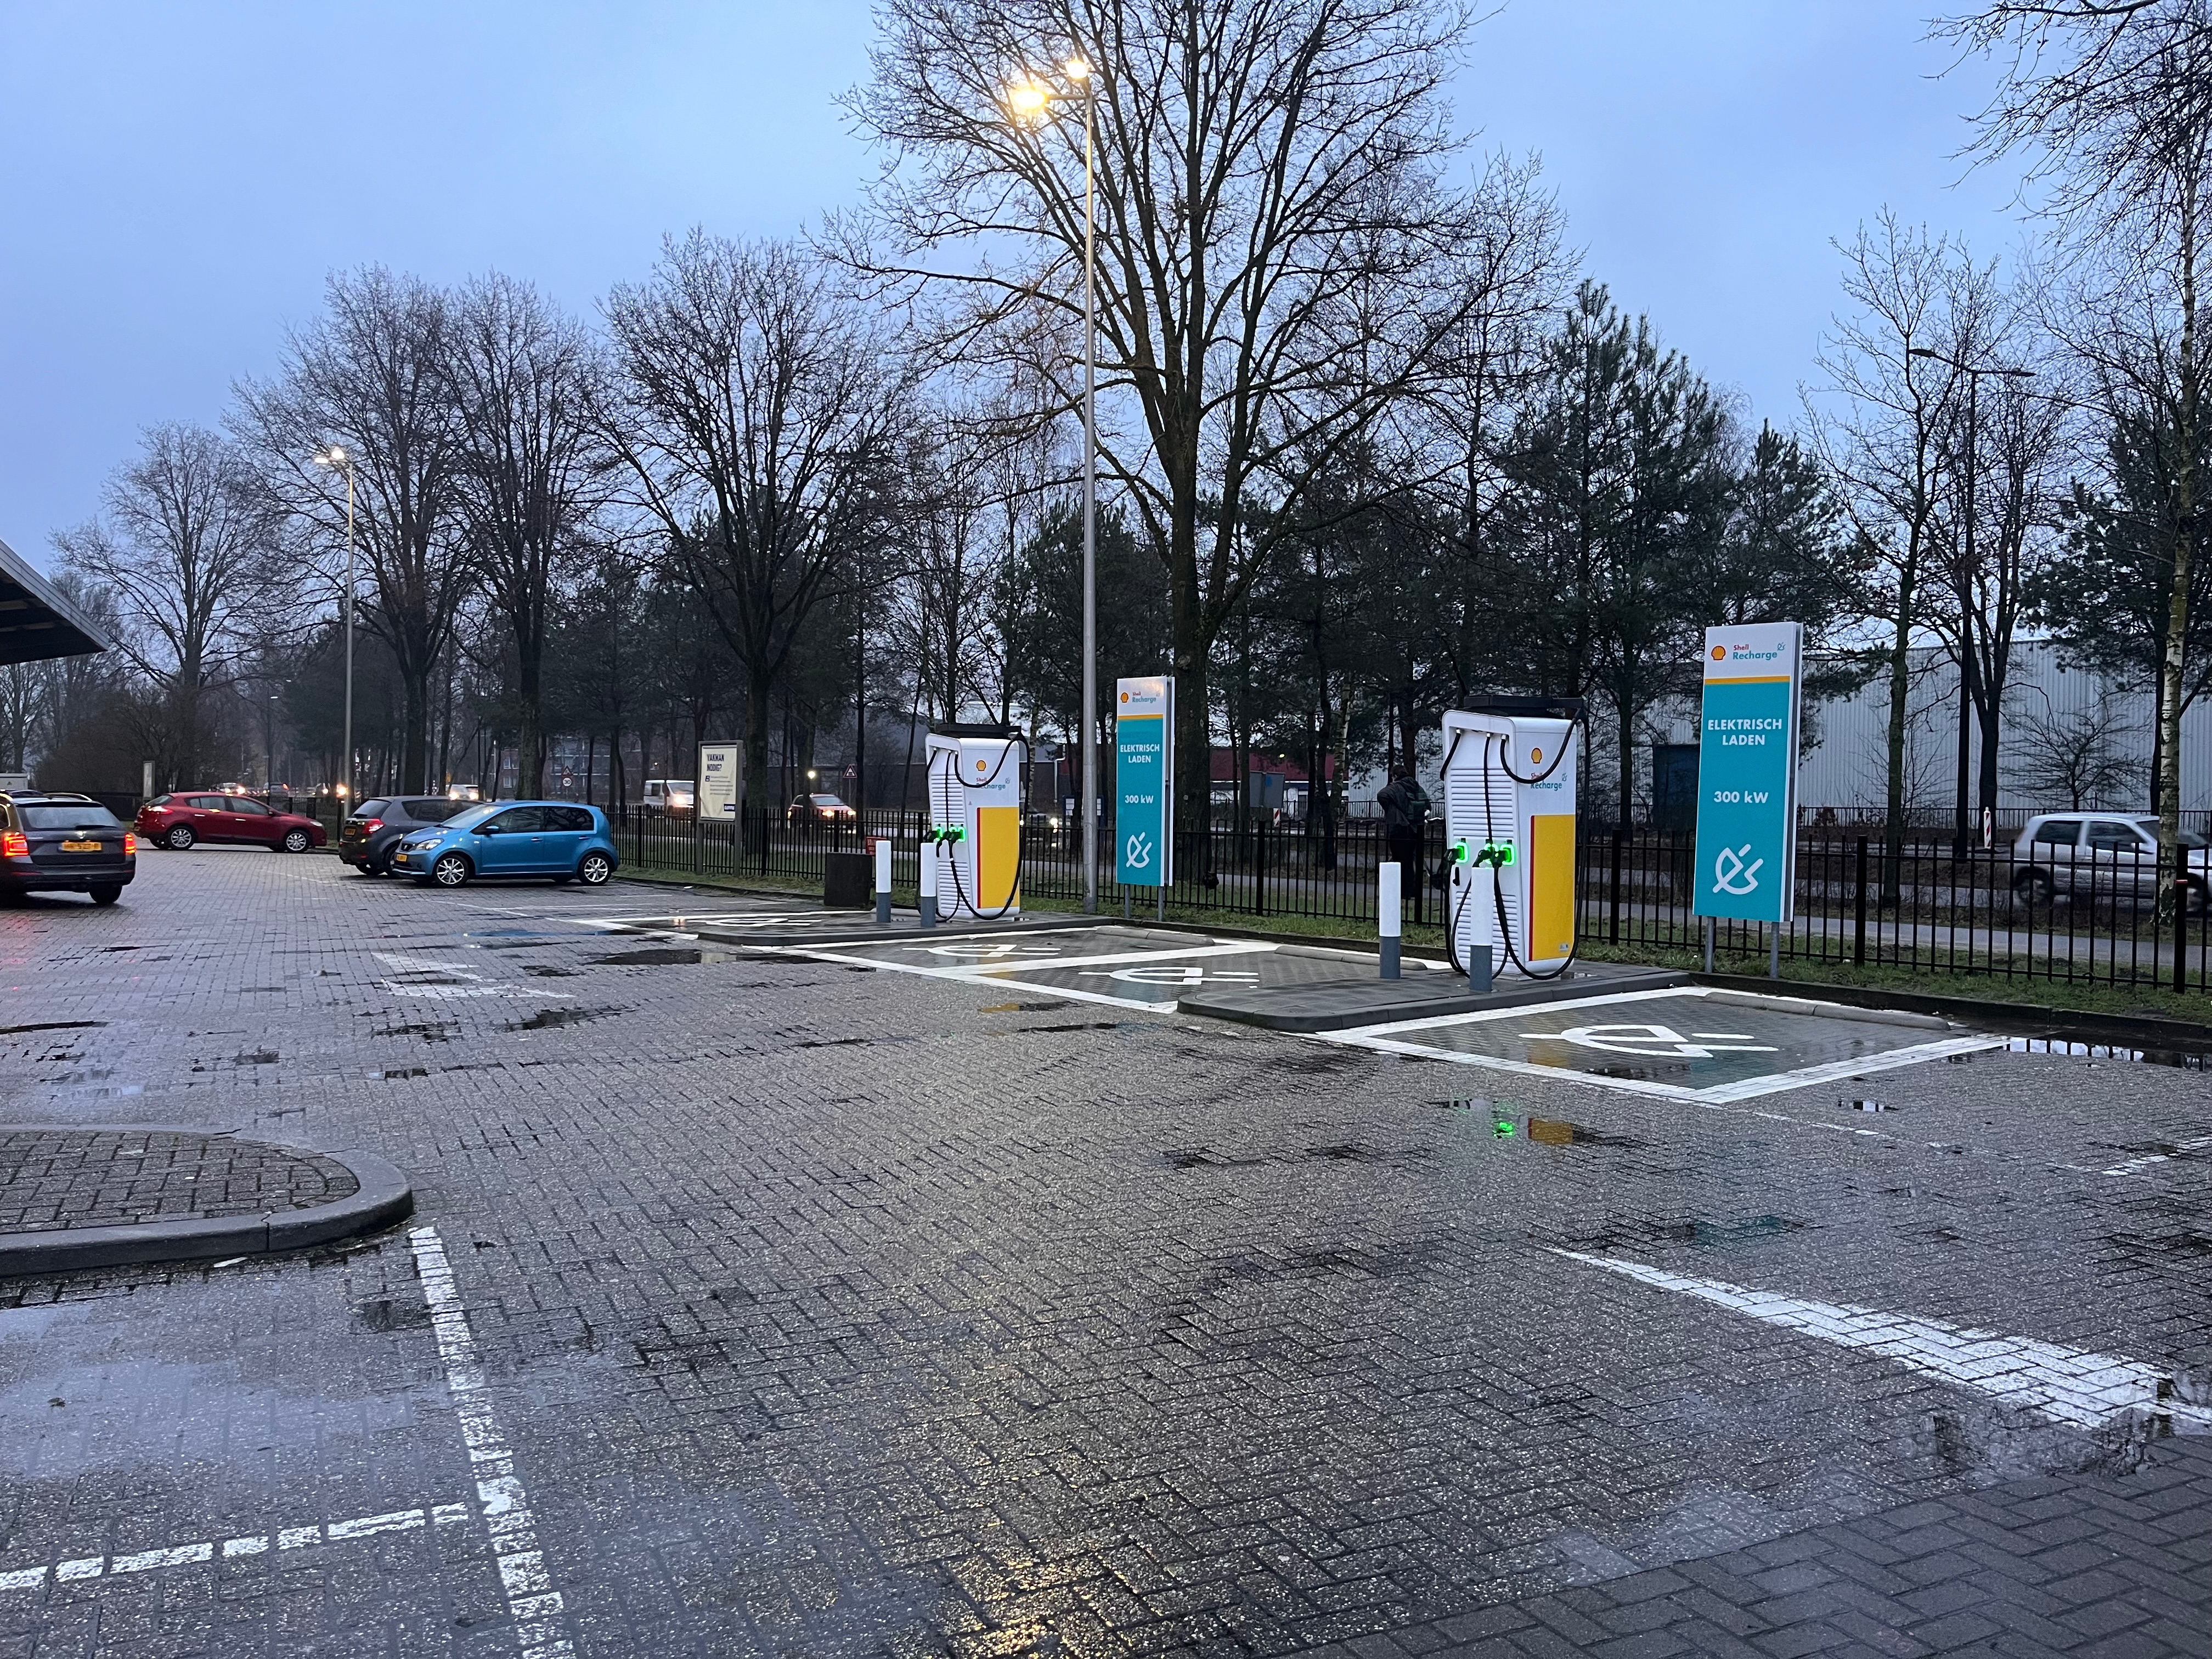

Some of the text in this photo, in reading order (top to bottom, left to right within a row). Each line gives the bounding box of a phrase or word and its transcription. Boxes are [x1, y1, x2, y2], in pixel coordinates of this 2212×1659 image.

[1733, 650, 1778, 661] Recharge
[1132, 695, 1156, 703] Recharge
[1708, 719, 1782, 730] ELEKTRISCH
[1722, 735, 1765, 746] LADEN
[1120, 744, 1160, 753] ELEKTRISCH
[1128, 755, 1152, 763] LADEN
[1125, 794, 1154, 804] 300 kW
[1713, 791, 1769, 804] 300 kW
